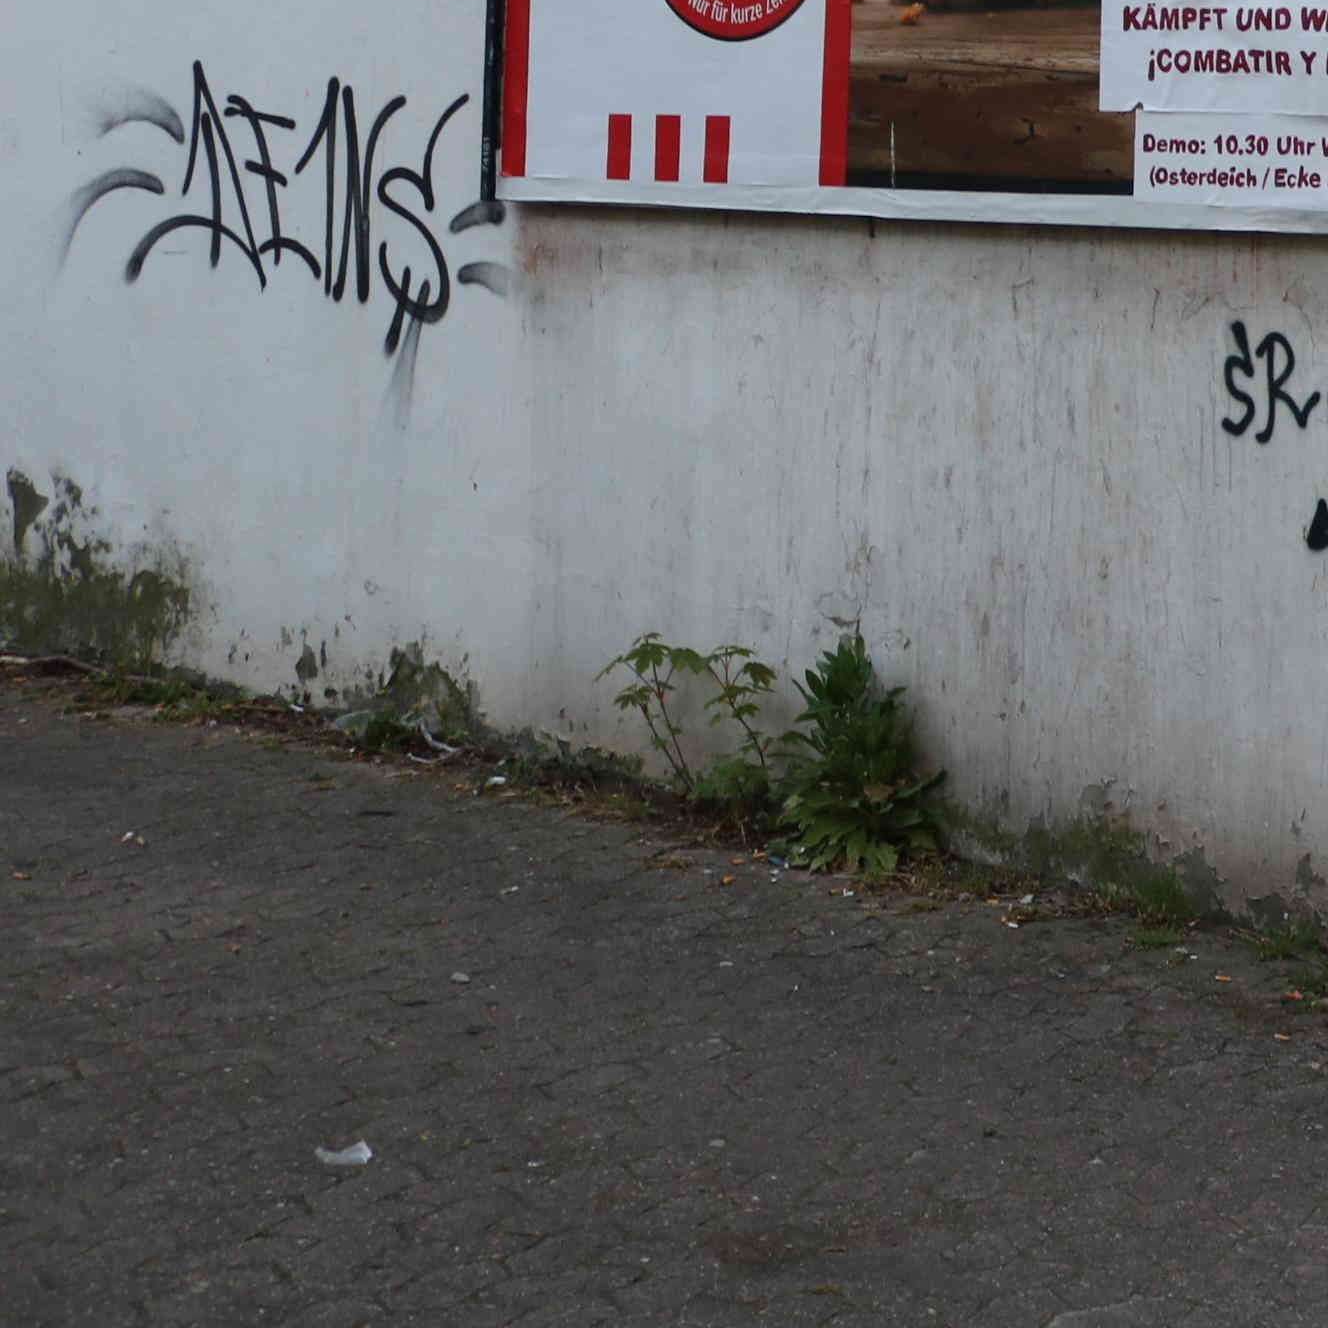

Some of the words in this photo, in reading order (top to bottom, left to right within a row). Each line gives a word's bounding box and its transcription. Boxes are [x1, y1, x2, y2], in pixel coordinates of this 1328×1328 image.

[712, 0, 729, 23] für
[731, 0, 763, 25] kurze
[1122, 3, 1227, 32] KÄMPFT
[1236, 7, 1291, 32] UND
[1148, 48, 1292, 81] ¡COMBATIR
[1300, 51, 1316, 75] Y
[1142, 134, 1206, 155] Demo:
[1213, 134, 1269, 156] 10.30
[1276, 136, 1316, 156] Uhr
[1149, 166, 1257, 188] (Osterdeich
[1274, 167, 1321, 189] Ecke
